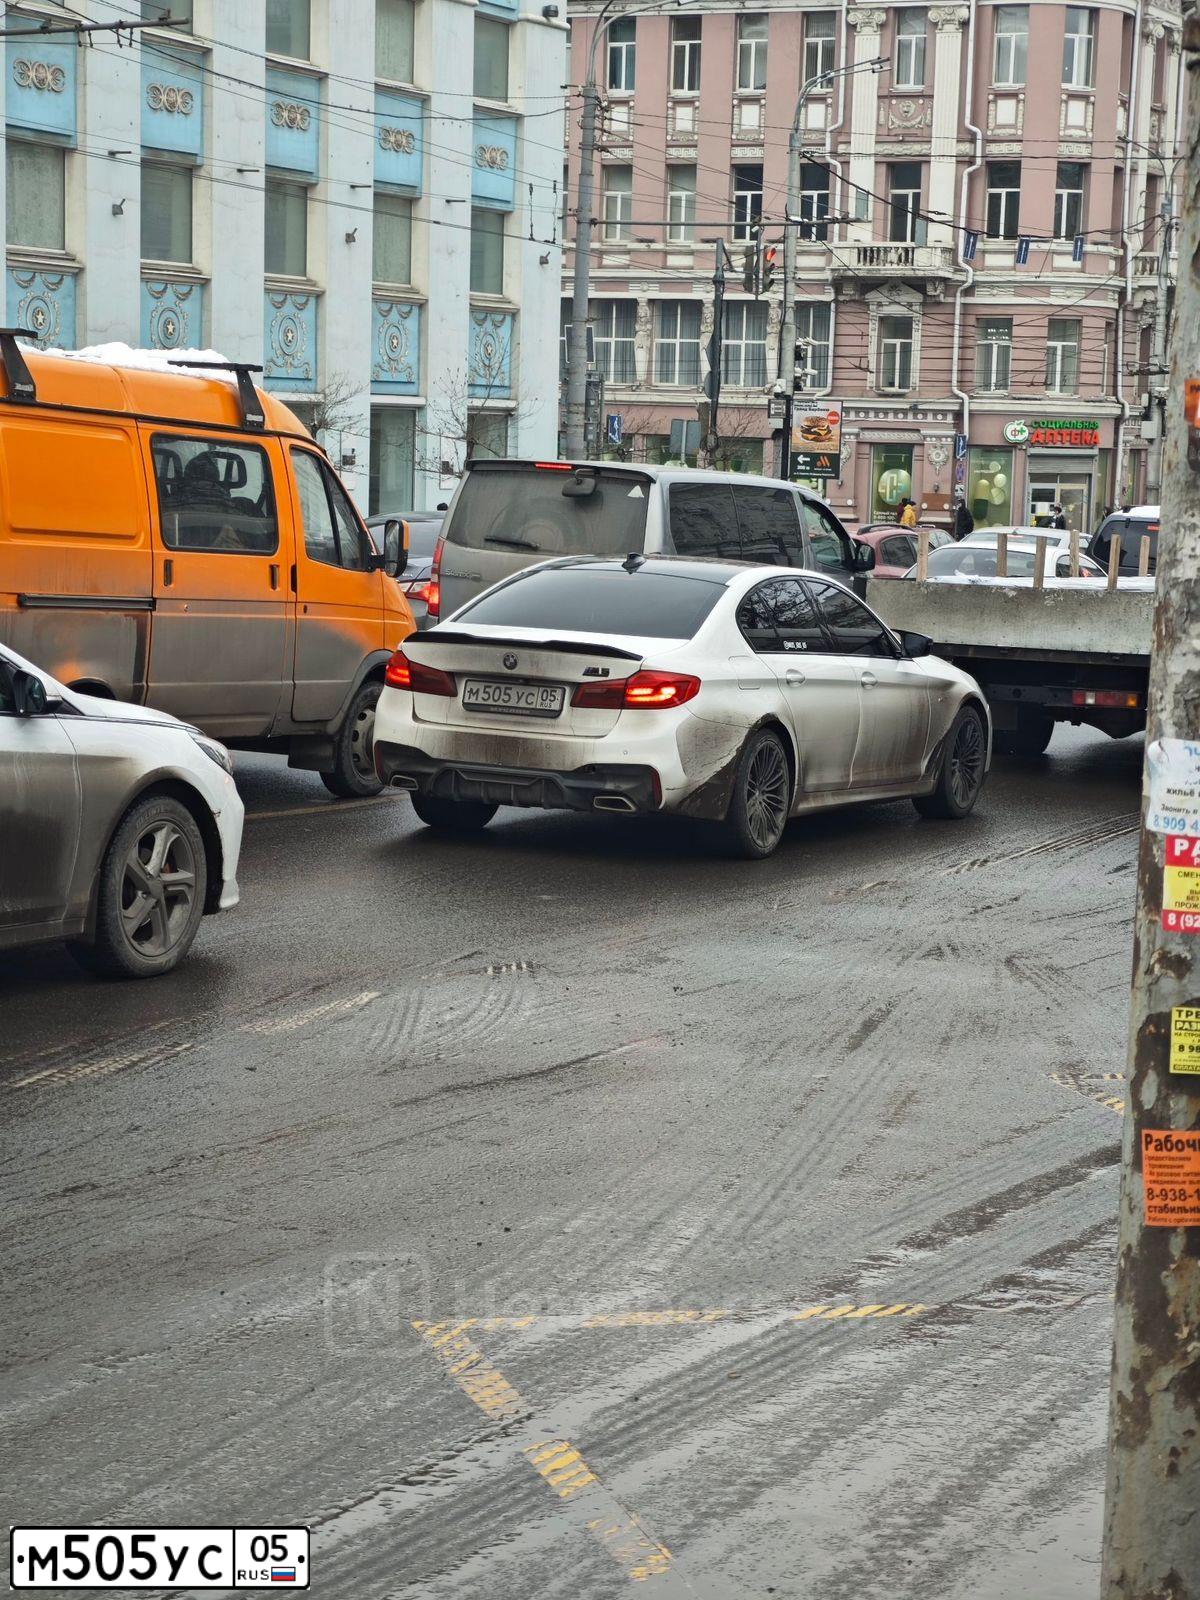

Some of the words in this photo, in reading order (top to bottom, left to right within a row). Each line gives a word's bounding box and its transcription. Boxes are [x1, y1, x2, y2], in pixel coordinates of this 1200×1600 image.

[1031, 419, 1099, 430] СОЦИАЛЬНАЯ
[1030, 429, 1101, 445] АПТЕКА
[467, 684, 536, 706] М505УС
[541, 688, 557, 703] 05
[1163, 815, 1187, 832] 909
